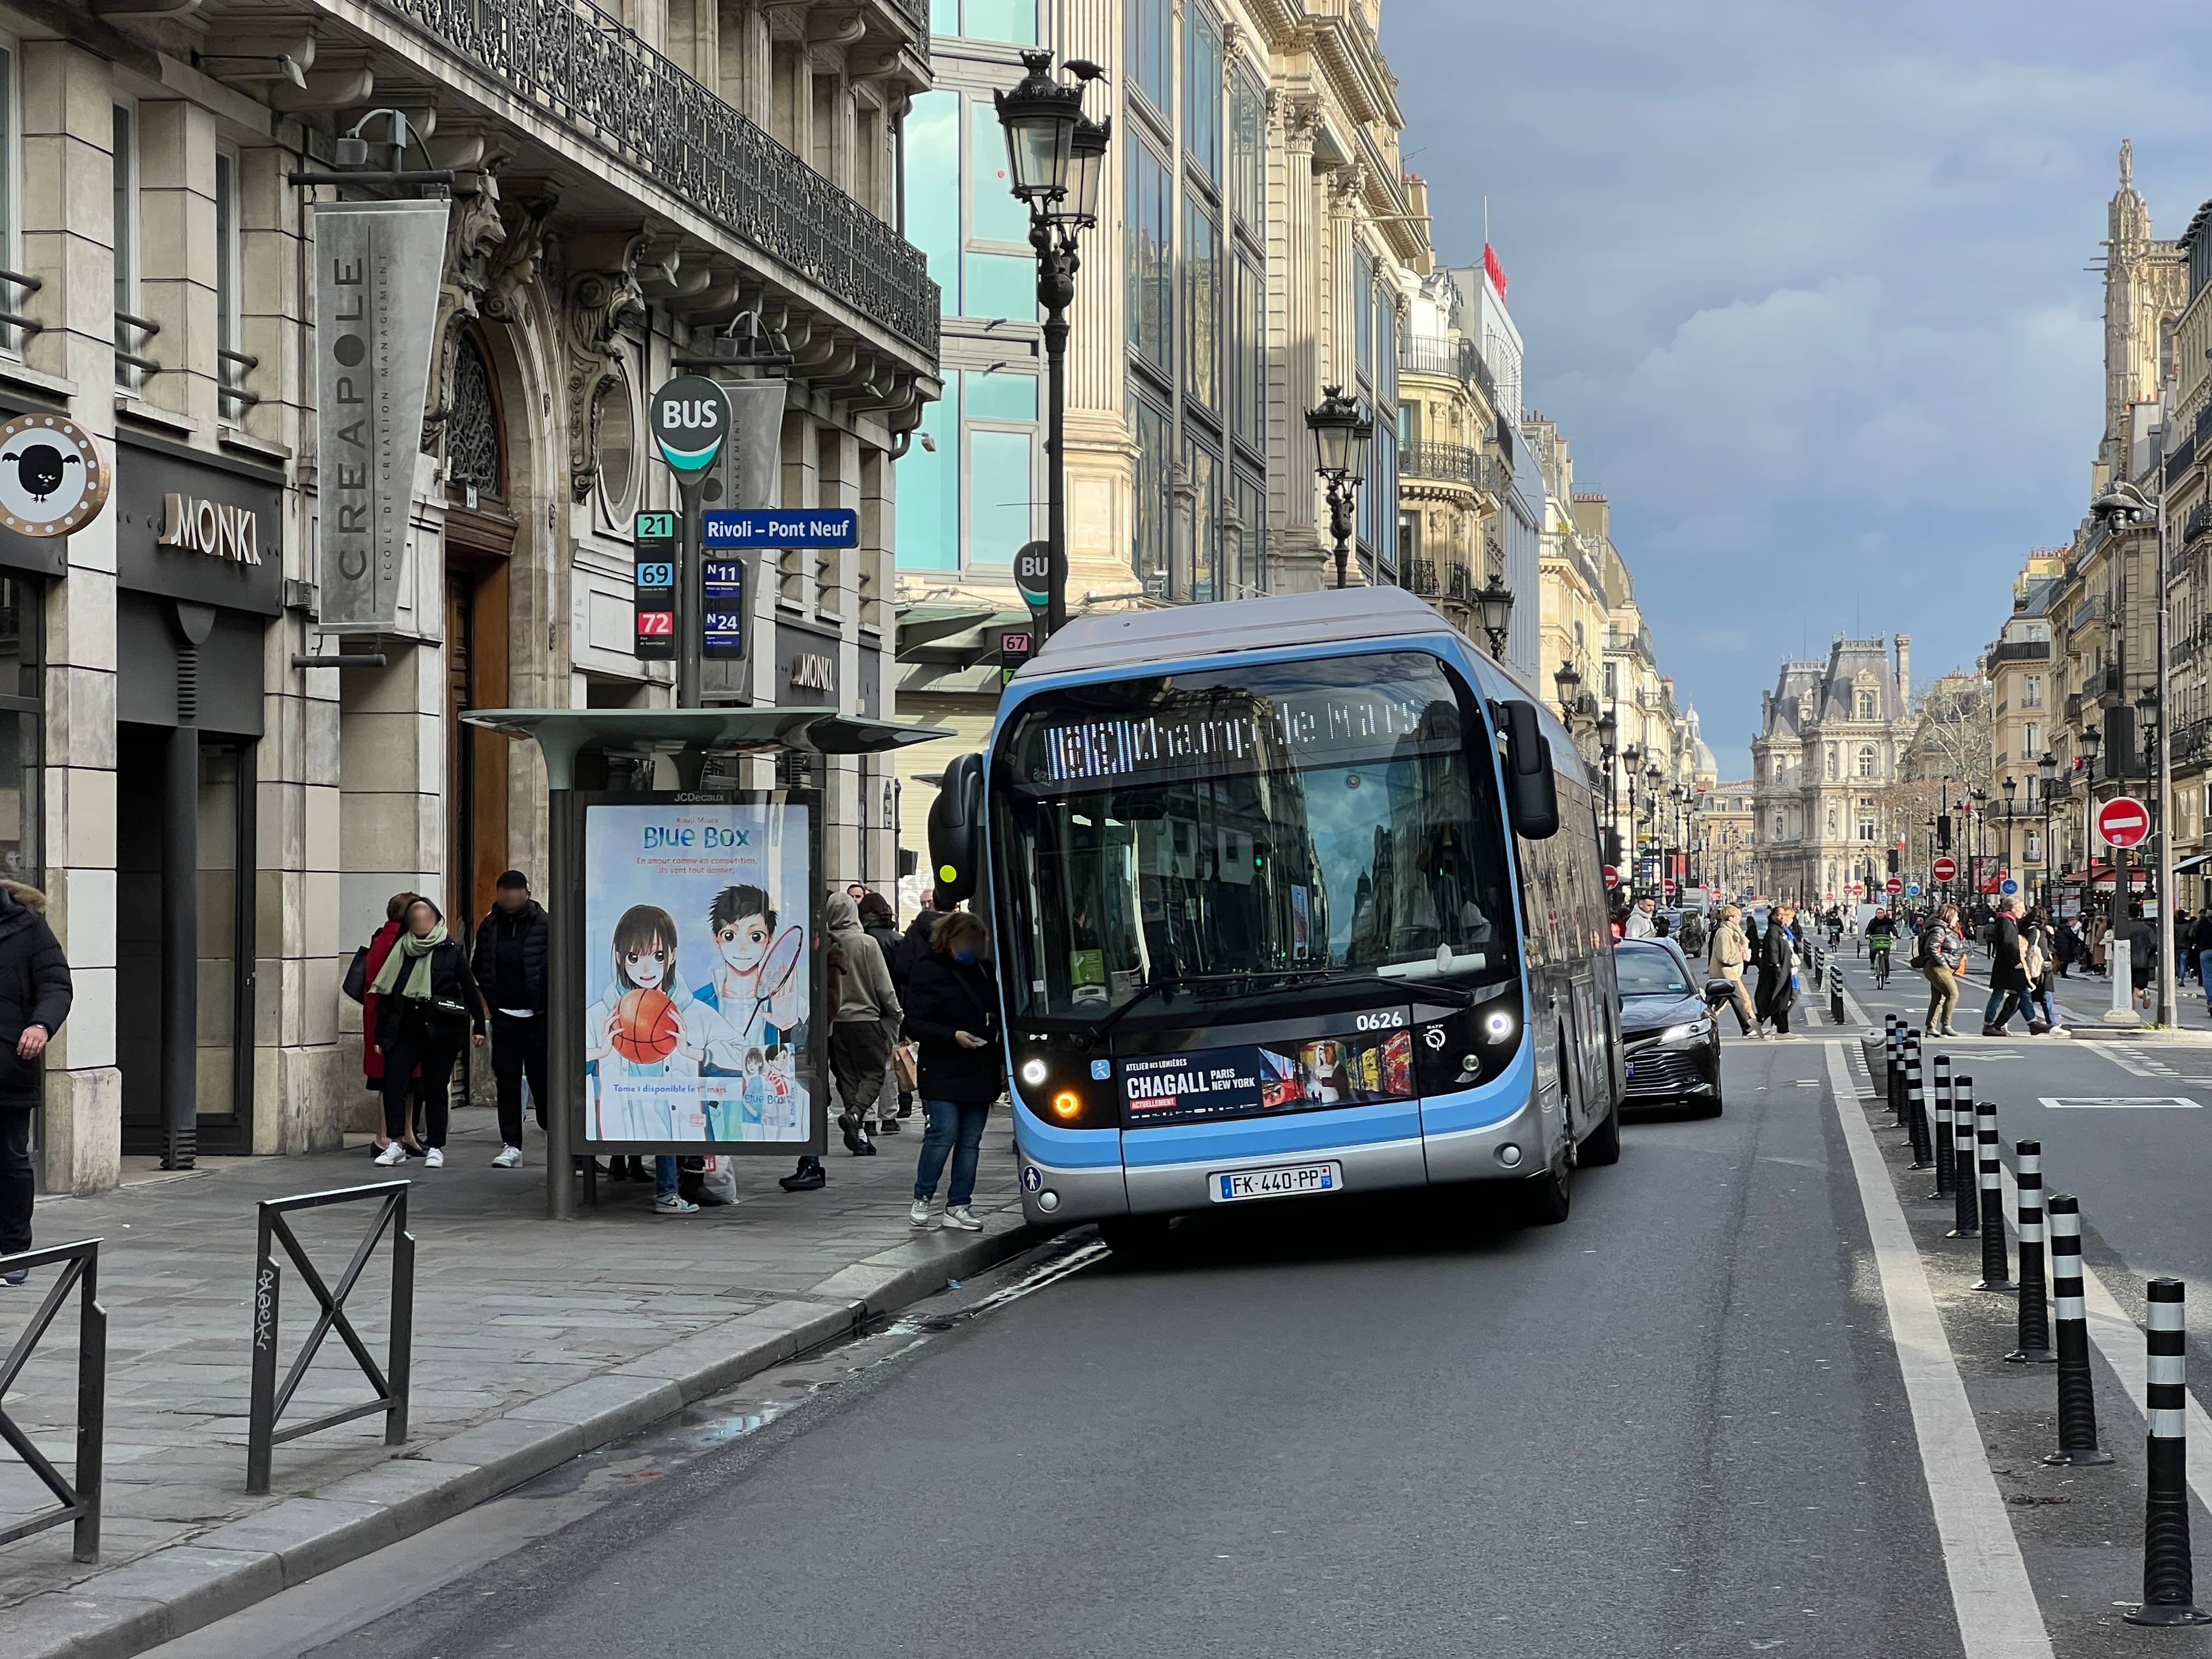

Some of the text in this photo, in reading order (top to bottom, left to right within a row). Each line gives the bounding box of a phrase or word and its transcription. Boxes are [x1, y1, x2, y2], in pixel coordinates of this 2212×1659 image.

[332, 257, 368, 581] CREAPOLE
[378, 253, 392, 581] ECOLE DE CREATION MANAGEMENT
[662, 399, 717, 429] BUS
[169, 494, 262, 566] MONKI
[643, 516, 666, 535] 21
[707, 521, 752, 537] Rivoli
[768, 521, 806, 537] Pont
[810, 520, 850, 537] Neuf
[642, 565, 669, 584] 69
[1021, 556, 1050, 577] BU
[642, 613, 669, 633] 72
[1006, 637, 1025, 650] 67
[798, 652, 834, 692] MONKI
[674, 793, 724, 802] JCDecaux
[643, 826, 751, 849] Blue Box
[1356, 1010, 1403, 1031] 0626
[1126, 1062, 1149, 1072] ATELIER
[1158, 1058, 1188, 1069] LUMIÈRES
[1210, 1068, 1236, 1080] PARIS
[613, 1084, 635, 1093] Tome
[642, 1084, 687, 1095] disponible
[687, 1084, 695, 1093] le
[1127, 1071, 1210, 1100] CHAGALL
[1211, 1077, 1256, 1091] NEW YORK
[1131, 1098, 1175, 1109] ACTUELLEMENT
[1232, 1169, 1319, 1195] FK-440-PP
[1321, 1177, 1331, 1186] 75
